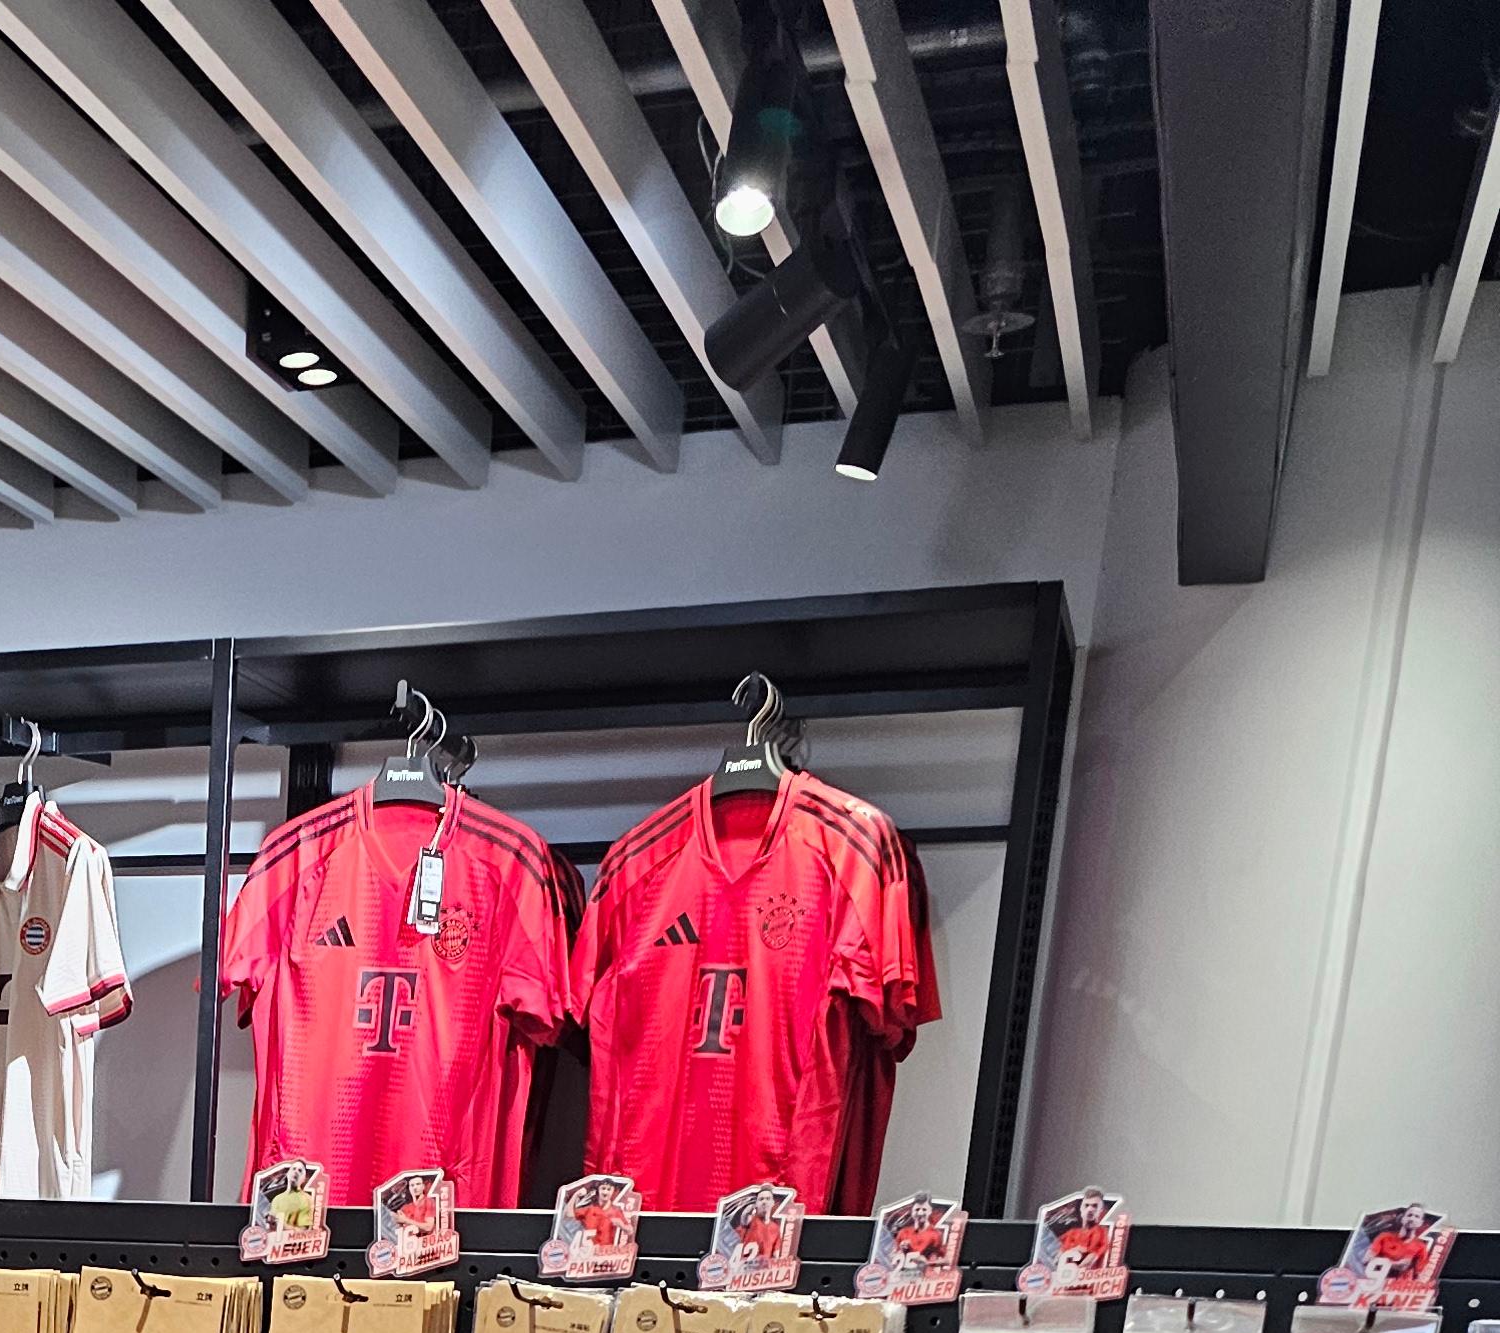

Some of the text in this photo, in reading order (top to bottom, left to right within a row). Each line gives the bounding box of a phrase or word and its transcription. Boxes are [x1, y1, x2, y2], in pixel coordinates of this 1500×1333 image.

[386, 768, 424, 782] FanTown
[724, 758, 762, 774] FanTown
[269, 1239, 323, 1259] NEUER
[398, 1247, 456, 1271] PALHINHA
[729, 1243, 760, 1272] 42
[1058, 1250, 1082, 1282] 6
[1078, 1265, 1126, 1282] JOSHUA
[1363, 1256, 1393, 1292] 9
[729, 1267, 796, 1287] MUSIALA
[891, 1280, 954, 1301] MÜLLER
[1351, 1292, 1428, 1312] KANE
